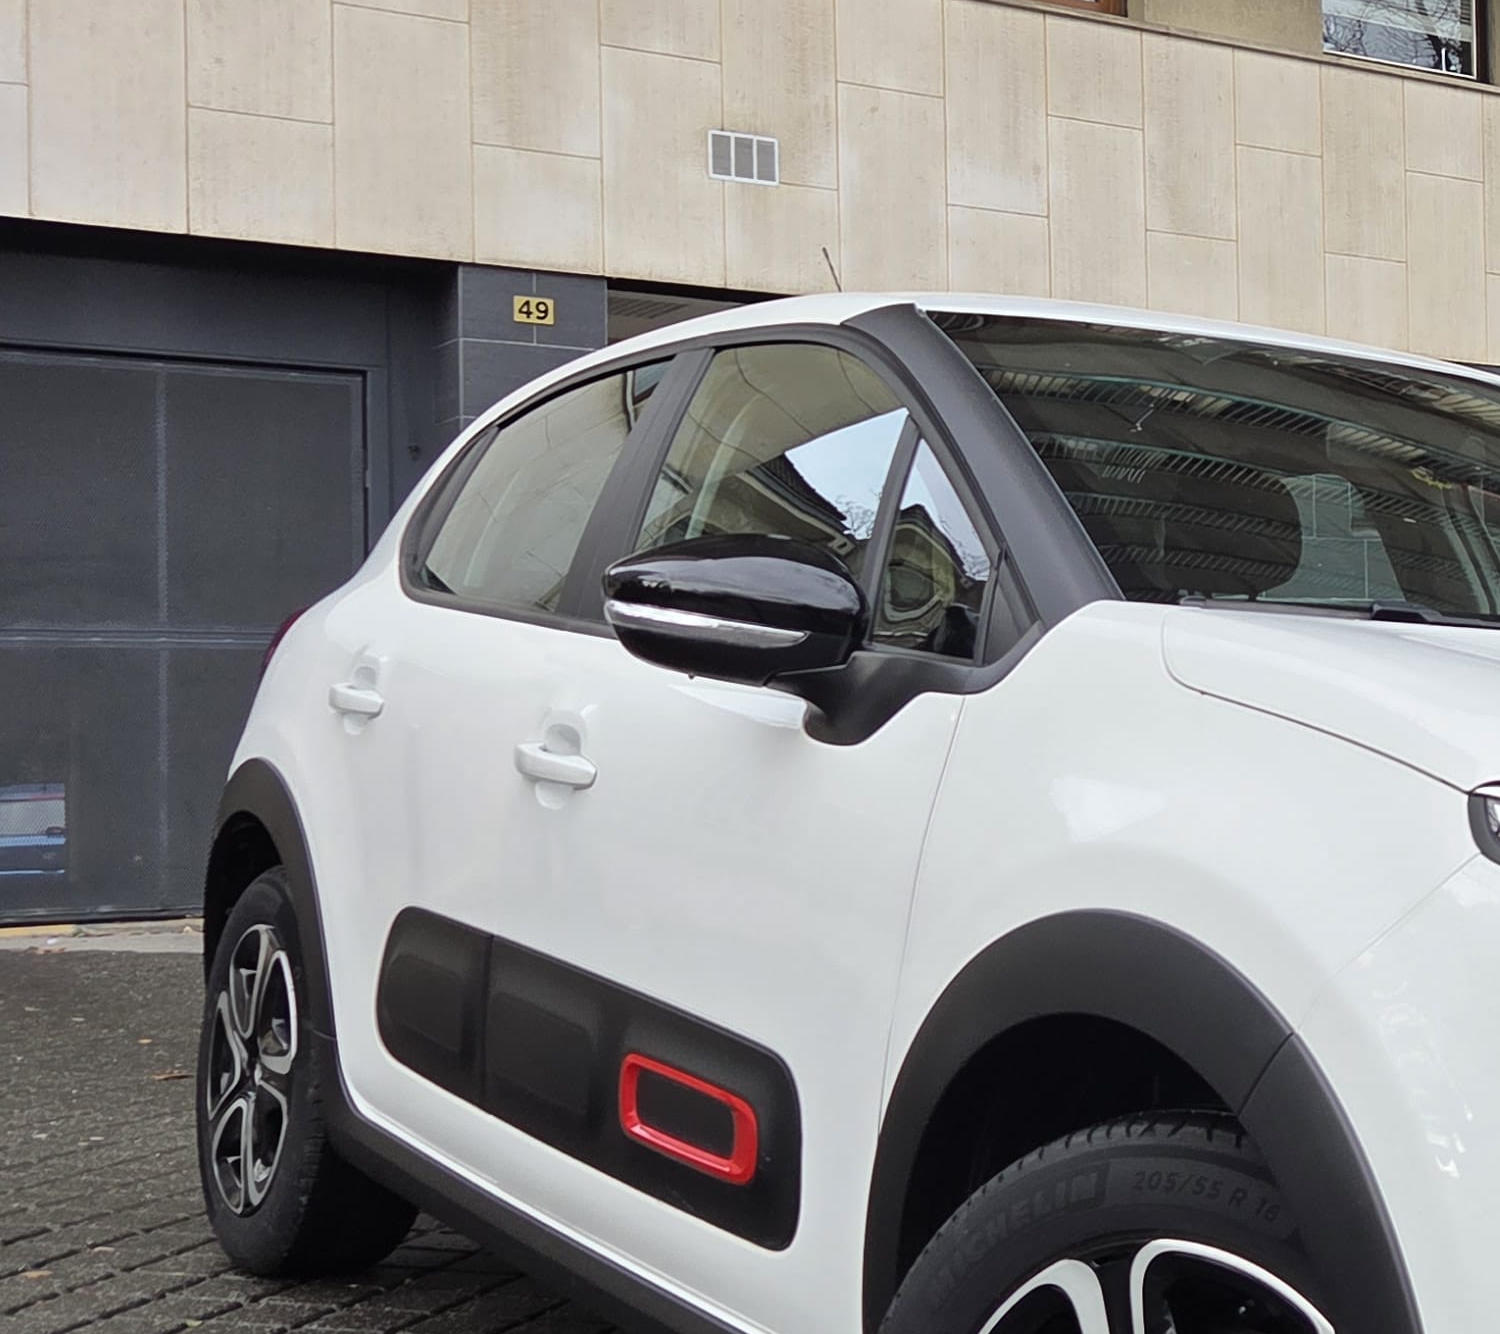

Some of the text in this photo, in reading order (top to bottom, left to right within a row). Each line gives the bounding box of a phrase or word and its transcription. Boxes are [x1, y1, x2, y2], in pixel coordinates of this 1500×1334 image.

[518, 299, 549, 320] 49
[1131, 1170, 1224, 1199] 205/55
[1227, 1186, 1249, 1208] R
